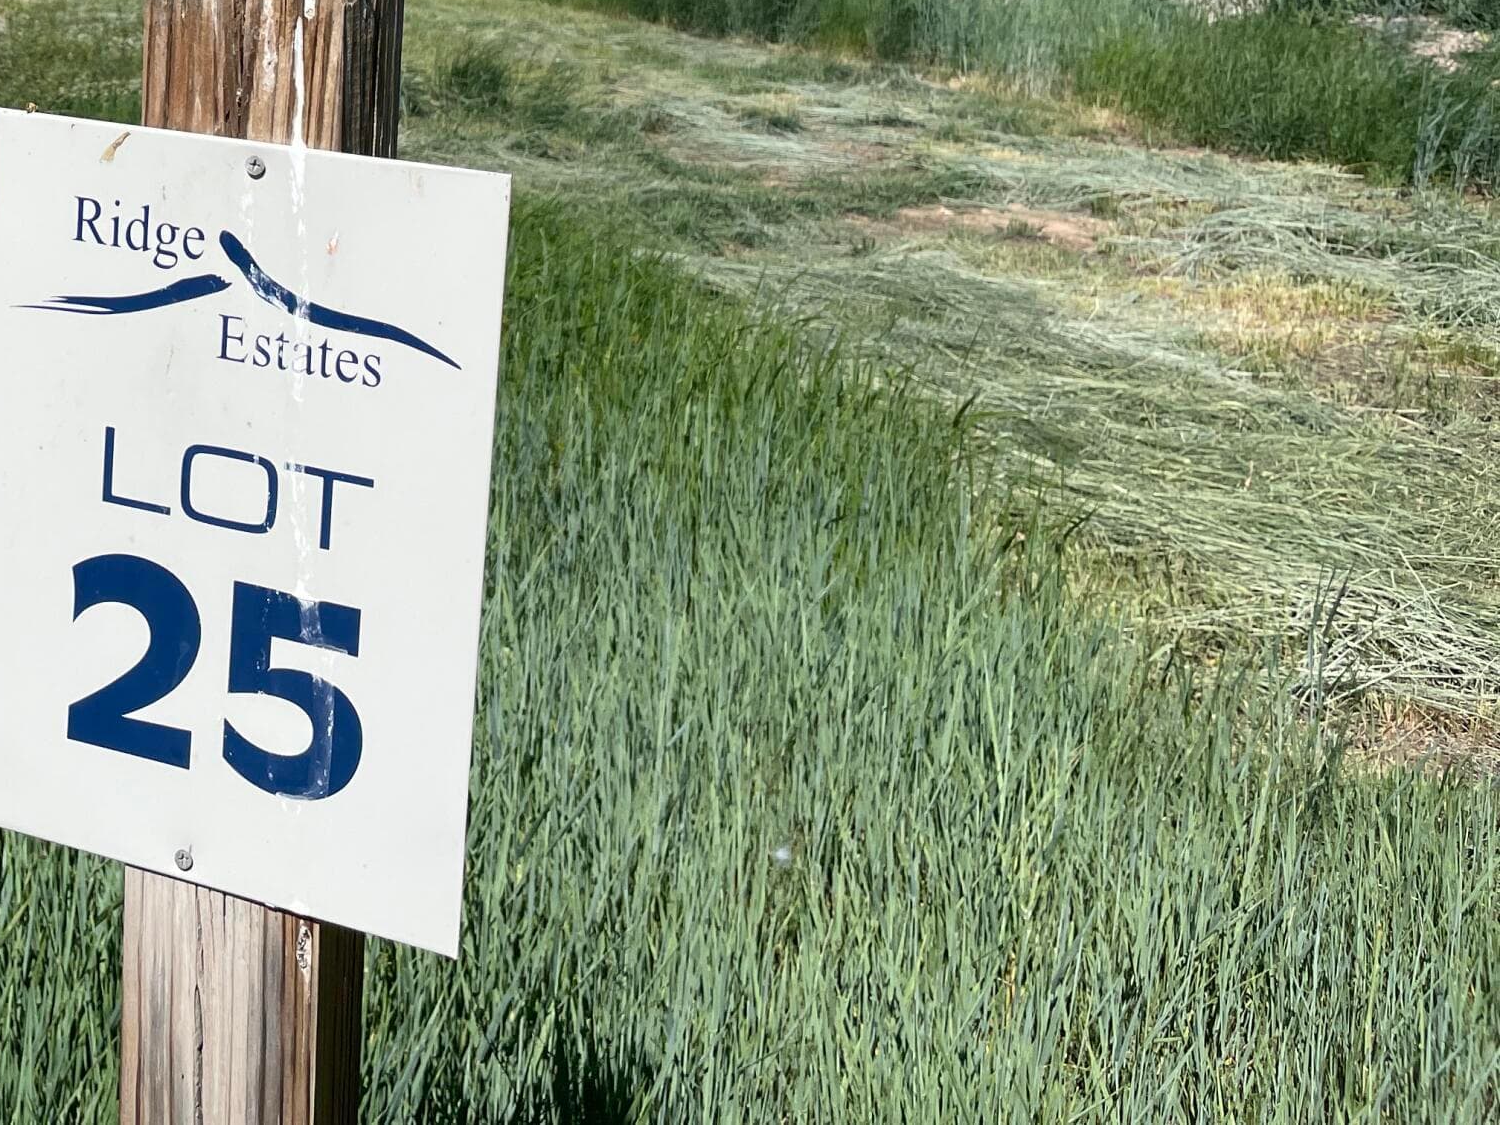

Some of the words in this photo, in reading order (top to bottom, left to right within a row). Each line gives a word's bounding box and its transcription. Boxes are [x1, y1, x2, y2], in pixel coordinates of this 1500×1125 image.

[71, 195, 205, 269] Ridge
[216, 313, 382, 388] Estates
[101, 425, 375, 551] LOT
[66, 552, 364, 801] 25
